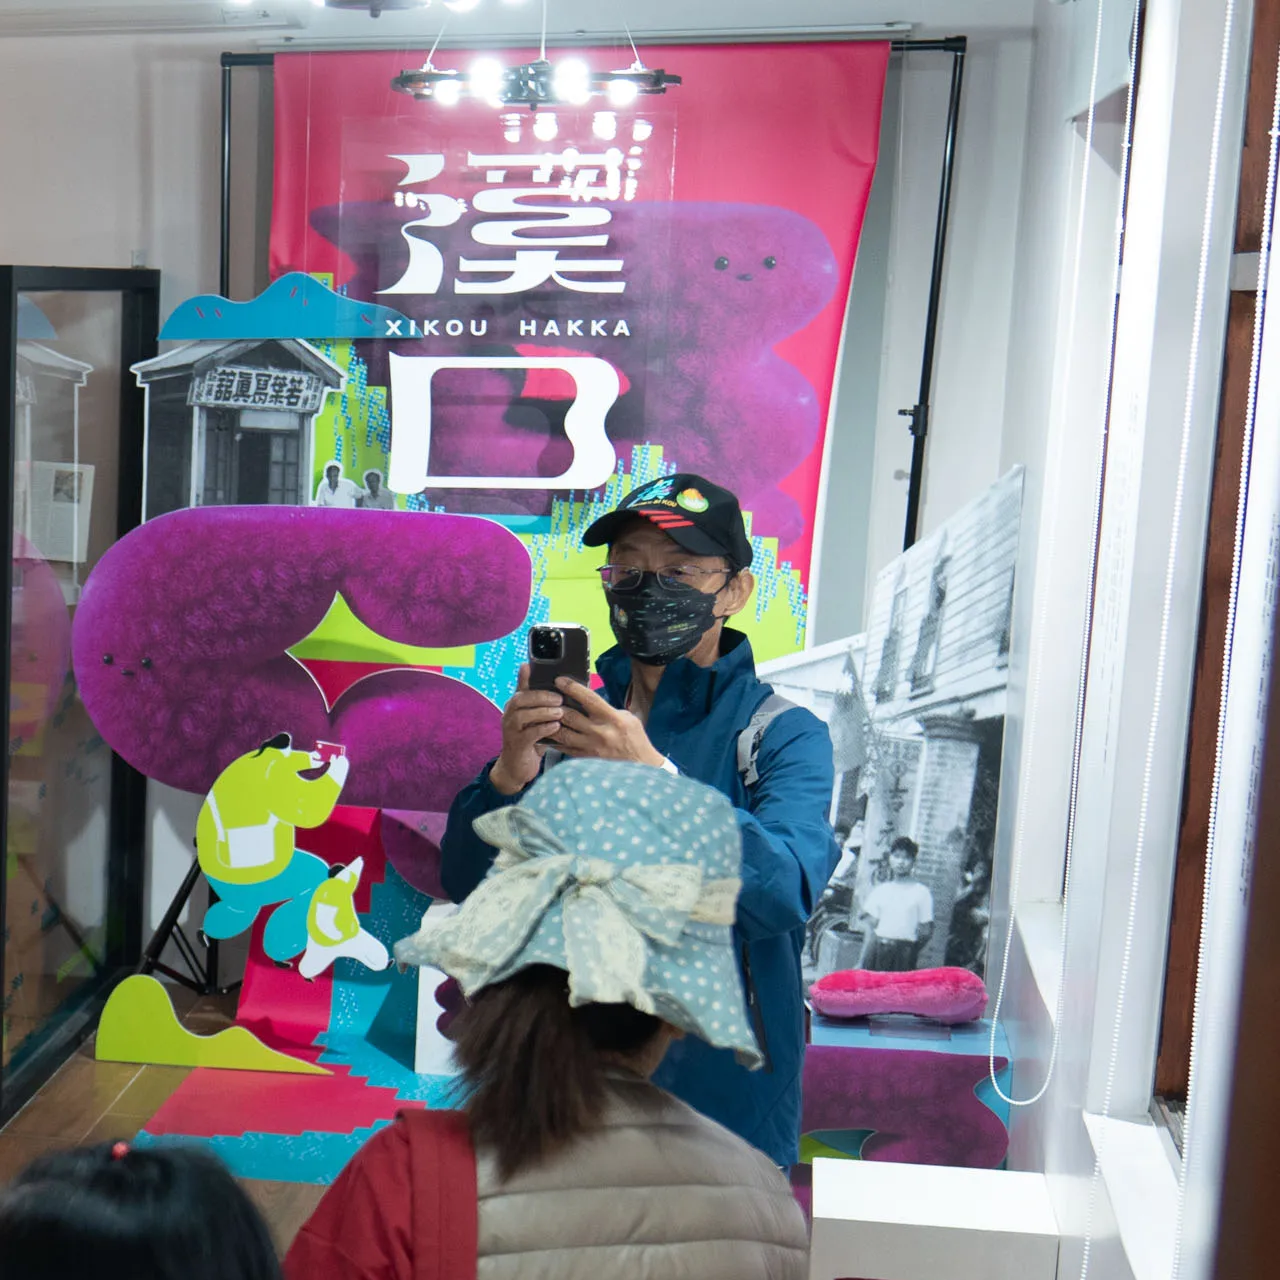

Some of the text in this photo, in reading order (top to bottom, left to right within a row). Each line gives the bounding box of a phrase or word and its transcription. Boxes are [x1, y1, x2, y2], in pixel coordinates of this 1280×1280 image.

[374, 152, 628, 296] 溪
[385, 319, 632, 337] XIKOU HAKKA
[387, 350, 621, 492] 口
